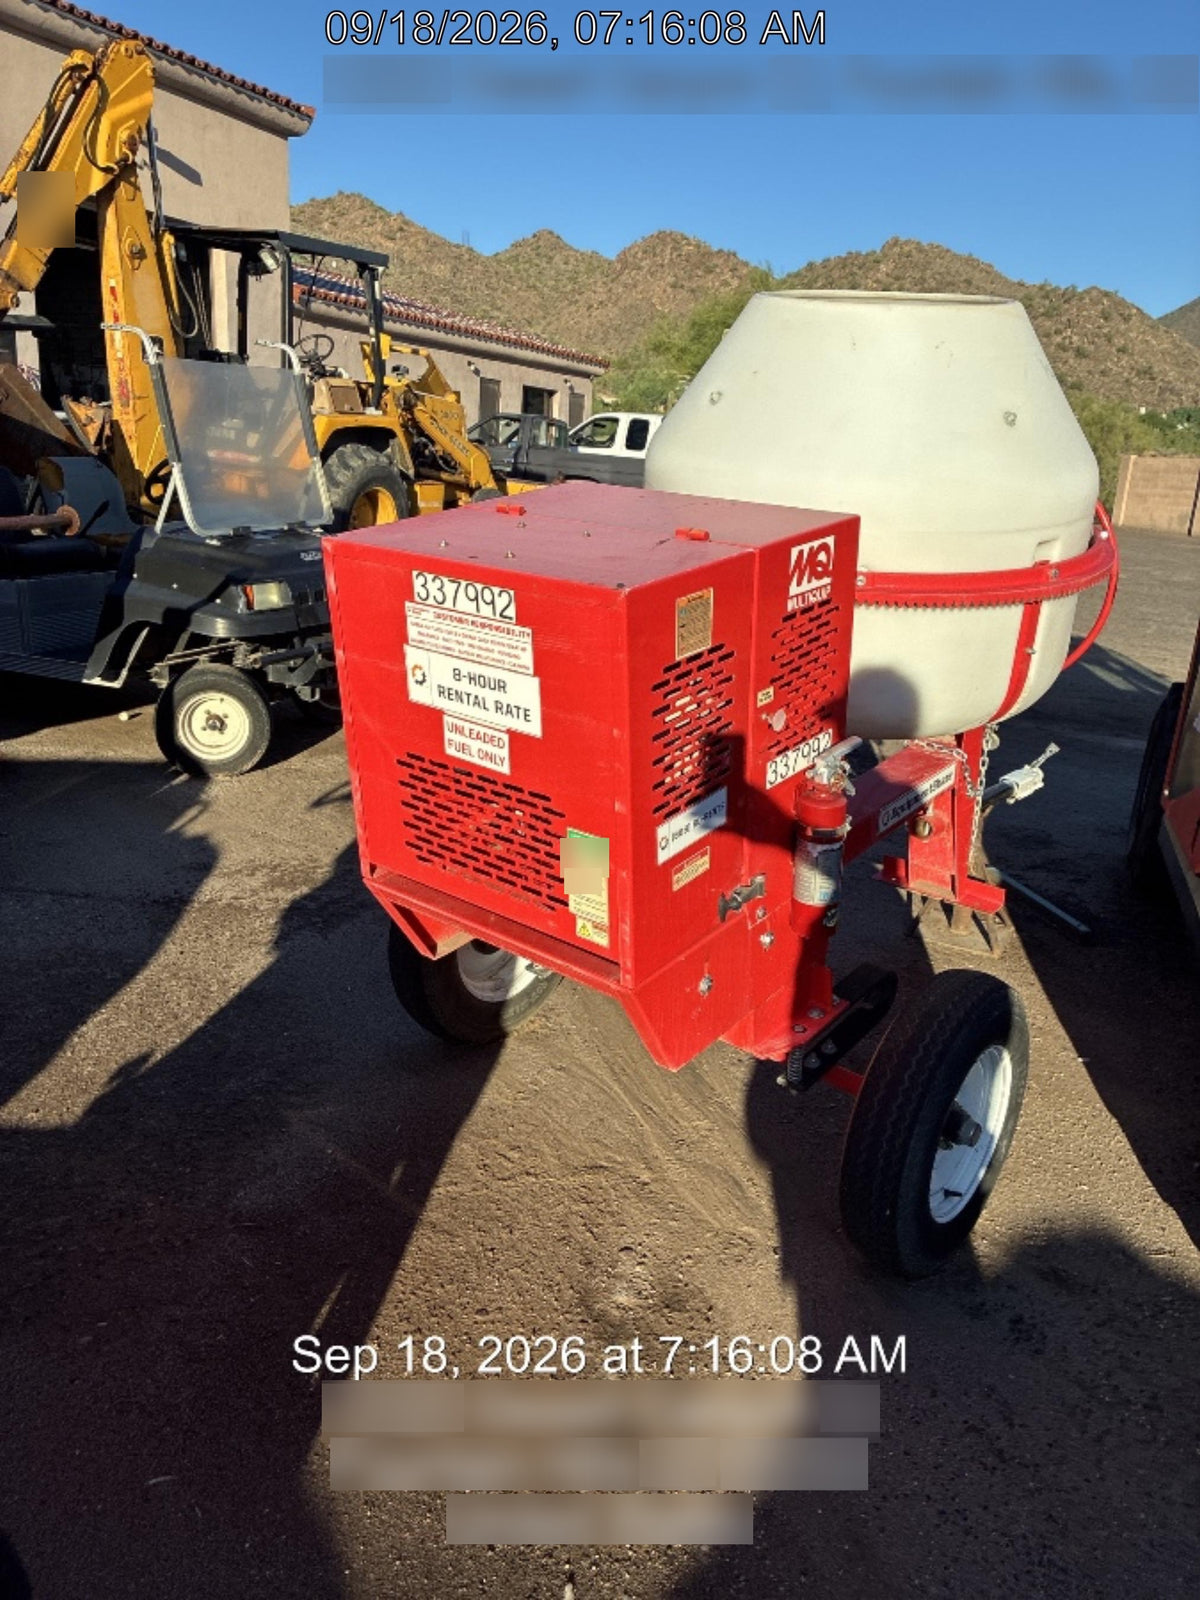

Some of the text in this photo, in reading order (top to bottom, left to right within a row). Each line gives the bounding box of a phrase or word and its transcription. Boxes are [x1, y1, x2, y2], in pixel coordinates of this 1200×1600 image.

[788, 541, 833, 588] MQ
[415, 572, 515, 620] 337992
[452, 667, 508, 694] 8-HOUR
[436, 684, 532, 724] RENTAL RATE
[445, 718, 506, 750] UNLEADED
[447, 738, 506, 768] FUEL ONLY
